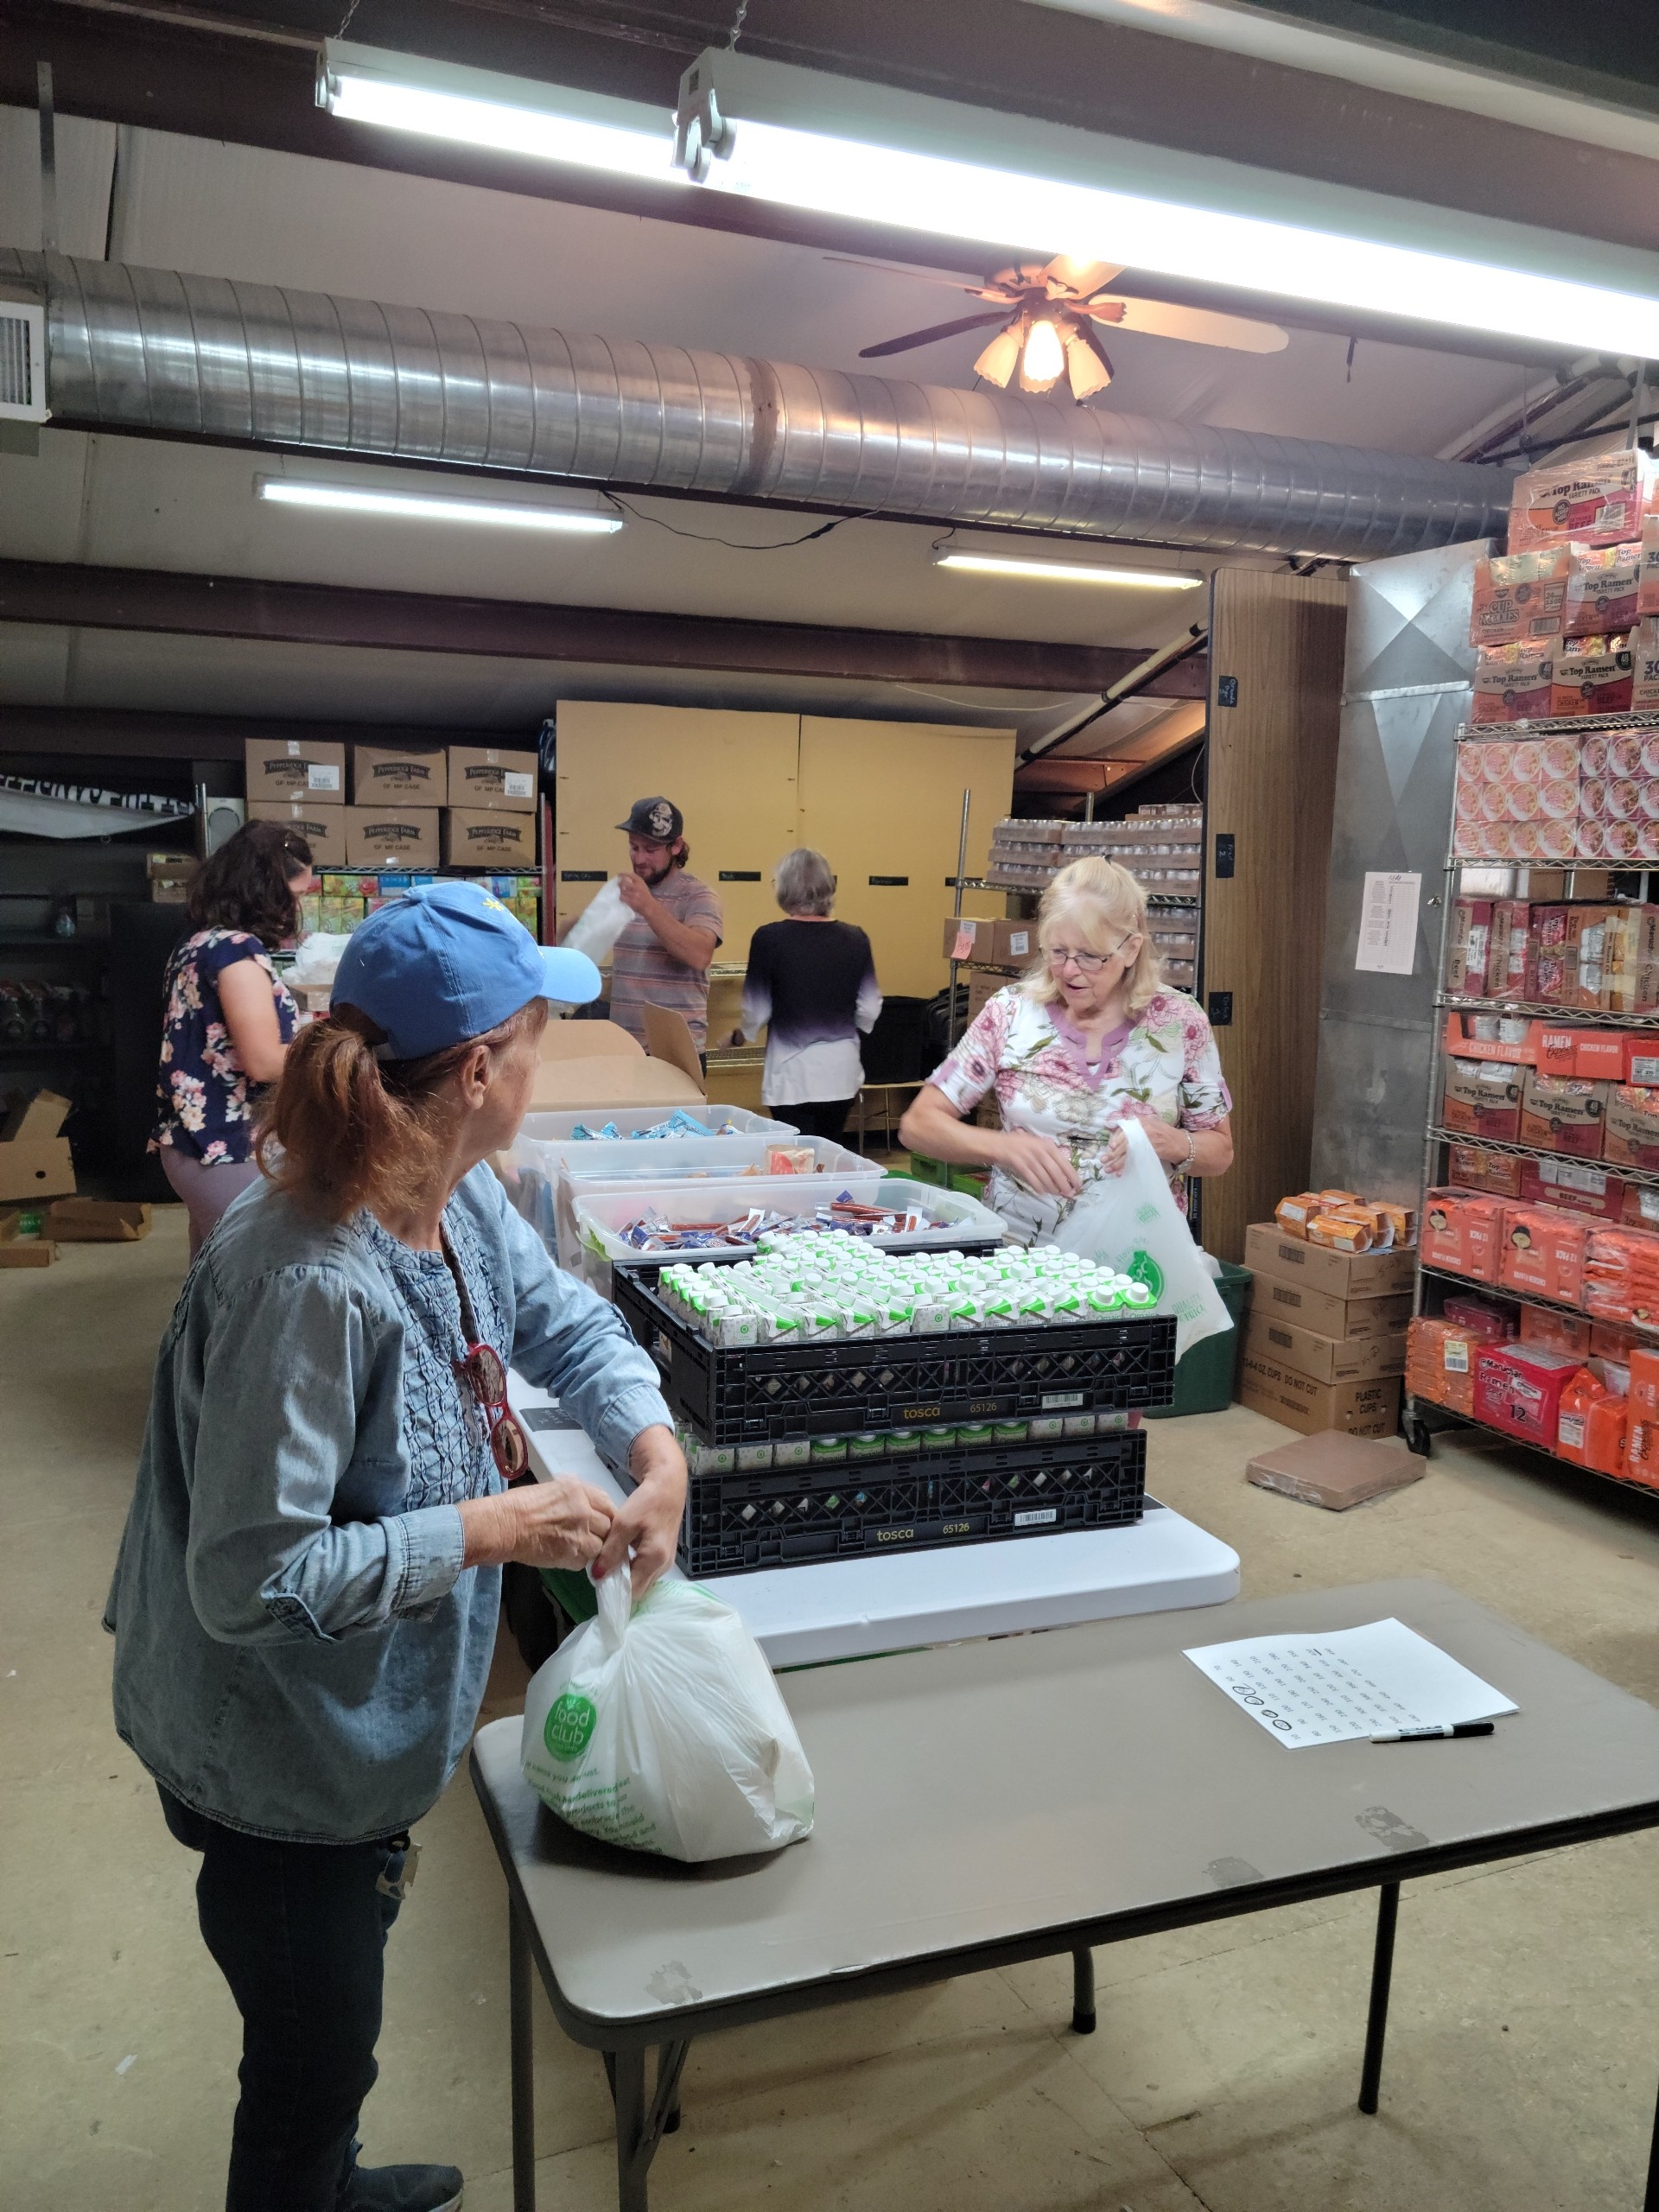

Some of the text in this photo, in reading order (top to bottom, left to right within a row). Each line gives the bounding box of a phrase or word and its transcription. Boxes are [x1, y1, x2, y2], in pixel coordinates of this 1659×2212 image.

[1568, 486, 1601, 499] VARIETY PACK
[1585, 578, 1632, 592] Top Ramen
[1490, 600, 1513, 613] CUP
[1479, 609, 1520, 626] NOODLES
[1569, 664, 1616, 677] Top Ramen
[1492, 674, 1537, 685] Top Ramen
[1469, 1042, 1496, 1055] CHICKEN
[1497, 1046, 1522, 1058] FLAVOR
[1541, 1034, 1618, 1053] RAMEN CHICKEN FLAVOR
[1547, 1044, 1578, 1058] Express
[1461, 1086, 1505, 1101] Top Ramen
[1538, 1100, 1584, 1116] Top Ramen
[1618, 1119, 1631, 1131] Top
[1559, 1192, 1578, 1201] BEEF
[1555, 1249, 1578, 1262] 12 PACK
[1486, 1358, 1524, 1380] Maruchan
[1267, 1368, 1318, 1396] CUPS DO NOT CUT
[1479, 1371, 1515, 1395] Ramen
[1356, 1389, 1382, 1402] PLASTIC
[903, 1402, 997, 1420] tosca 65126
[1359, 1402, 1376, 1414] CUPS
[1510, 1404, 1526, 1422] 12
[1372, 1422, 1385, 1433] CUT
[1629, 1425, 1643, 1464] RAMEN
[876, 1522, 969, 1542] tosca 65126
[556, 1700, 591, 1727] food
[551, 1726, 584, 1745] club
